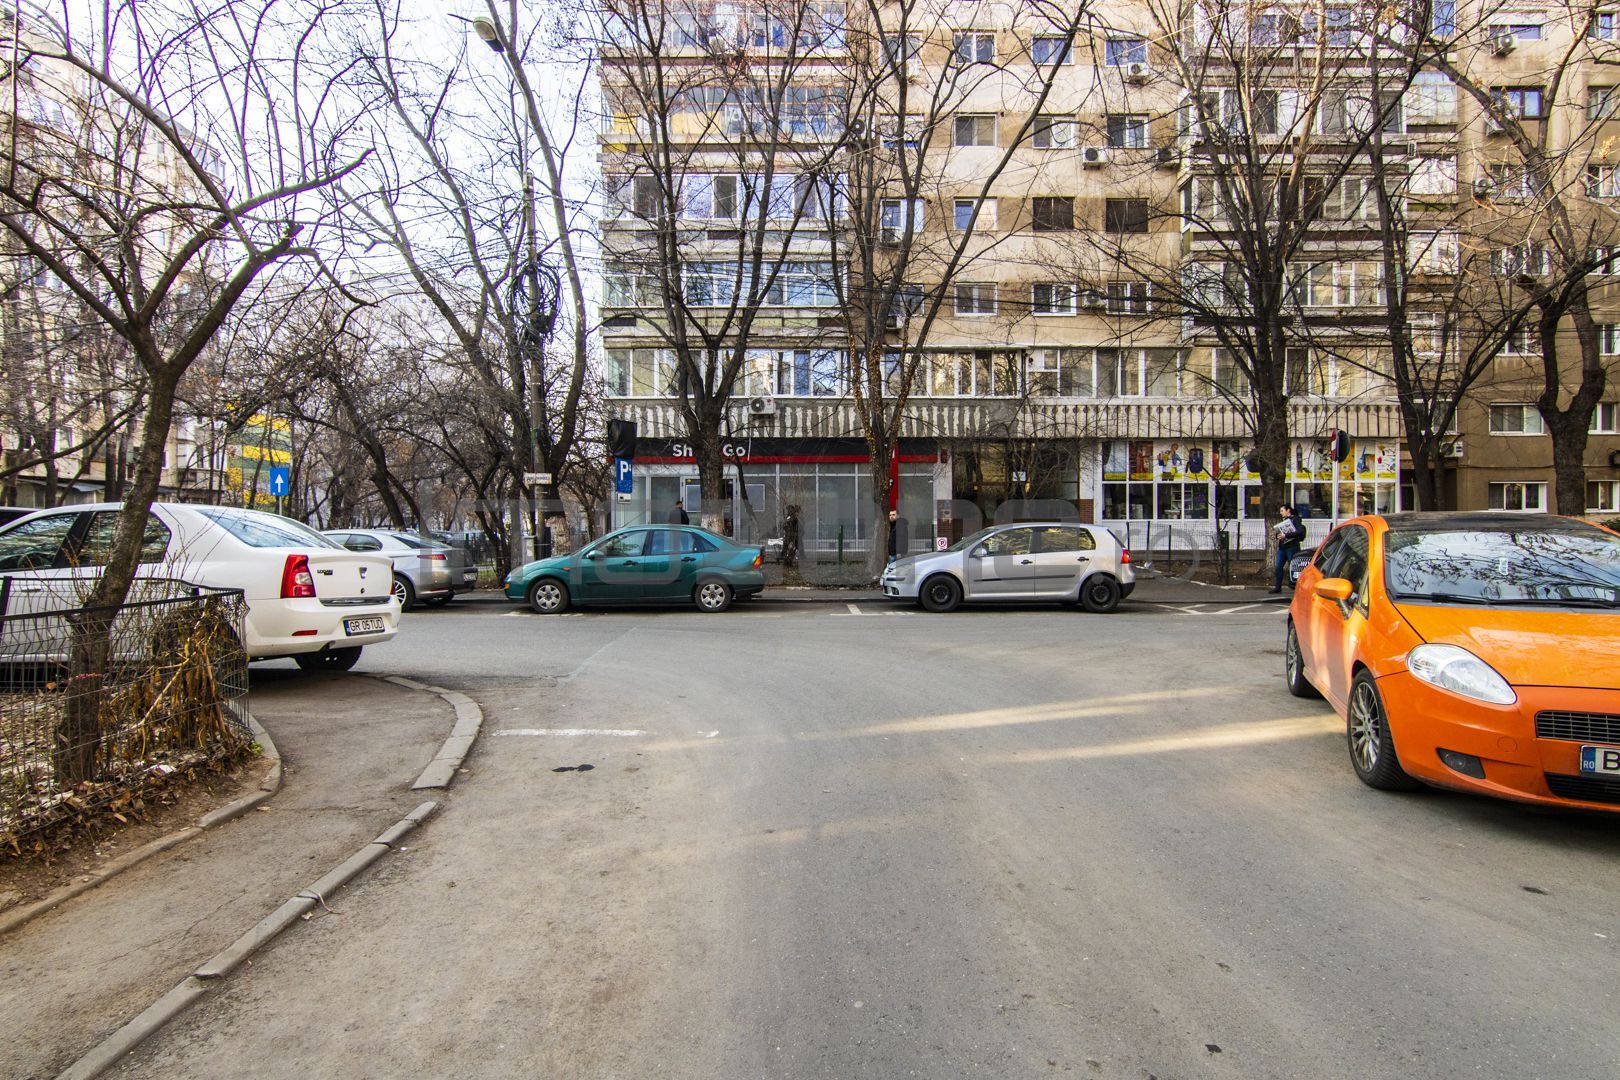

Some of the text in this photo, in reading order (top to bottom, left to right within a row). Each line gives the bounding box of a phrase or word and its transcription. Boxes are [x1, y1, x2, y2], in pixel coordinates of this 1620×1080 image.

[620, 460, 629, 481] P
[350, 621, 360, 631] GR
[1583, 760, 1595, 769] RO
[1603, 750, 1620, 770] B
